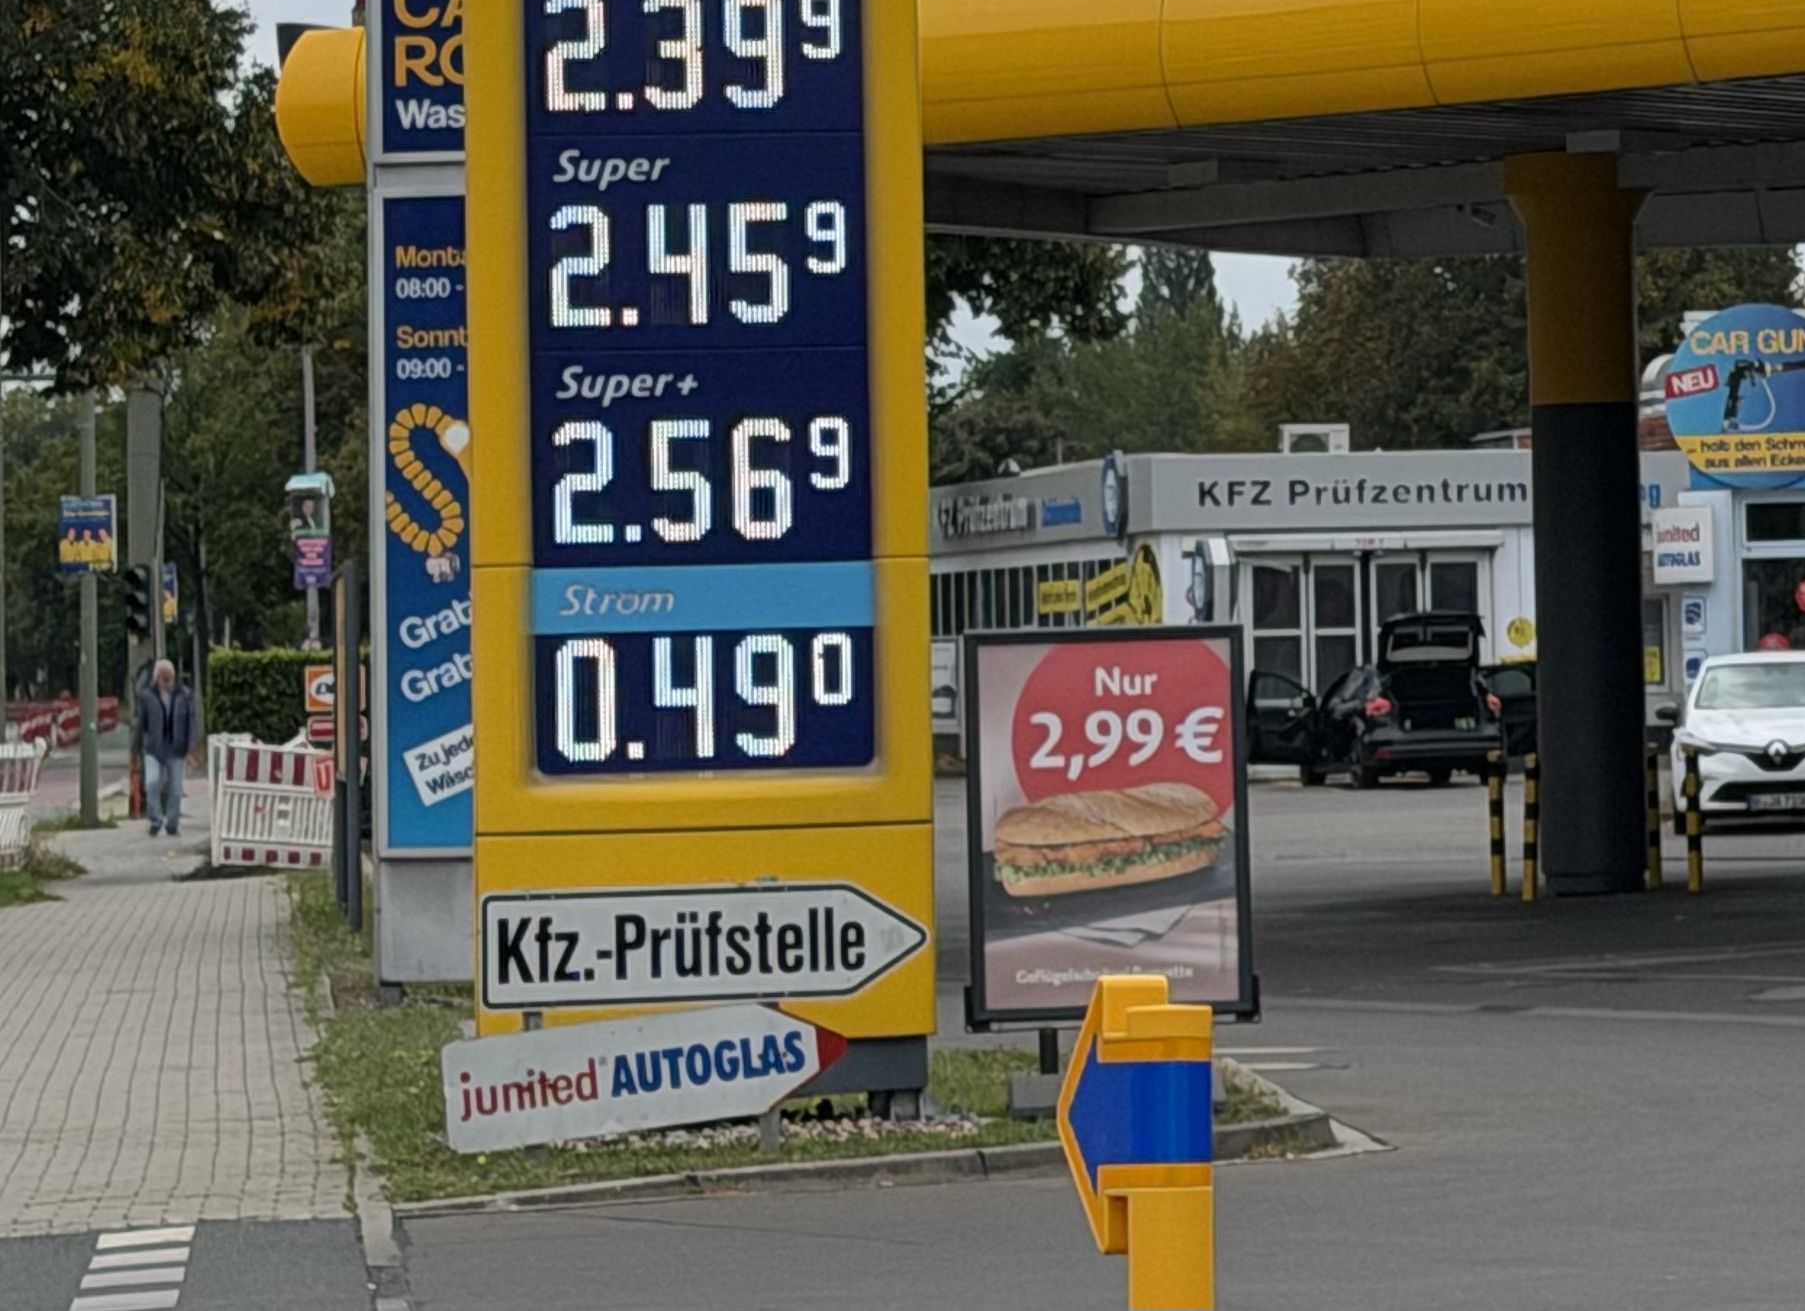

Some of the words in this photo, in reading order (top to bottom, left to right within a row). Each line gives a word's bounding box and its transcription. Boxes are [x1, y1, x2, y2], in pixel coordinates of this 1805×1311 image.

[552, 149, 670, 191] Super
[396, 277, 451, 299] 08:00
[1690, 329, 1749, 356] CAR
[397, 357, 451, 380] 09:00
[1671, 368, 1715, 395] NEU
[555, 365, 699, 408] Super+
[1734, 439, 1761, 452] den
[1197, 480, 1273, 507] KFZ
[1287, 478, 1528, 506] Prüfzentrum
[559, 583, 675, 617] Strom
[399, 597, 473, 649] Grat
[1094, 666, 1158, 696] Nur
[497, 906, 867, 986] Kfz.-Prüfstelle
[459, 1057, 599, 1122] junited
[611, 1031, 807, 1099] AUTOGLAS
